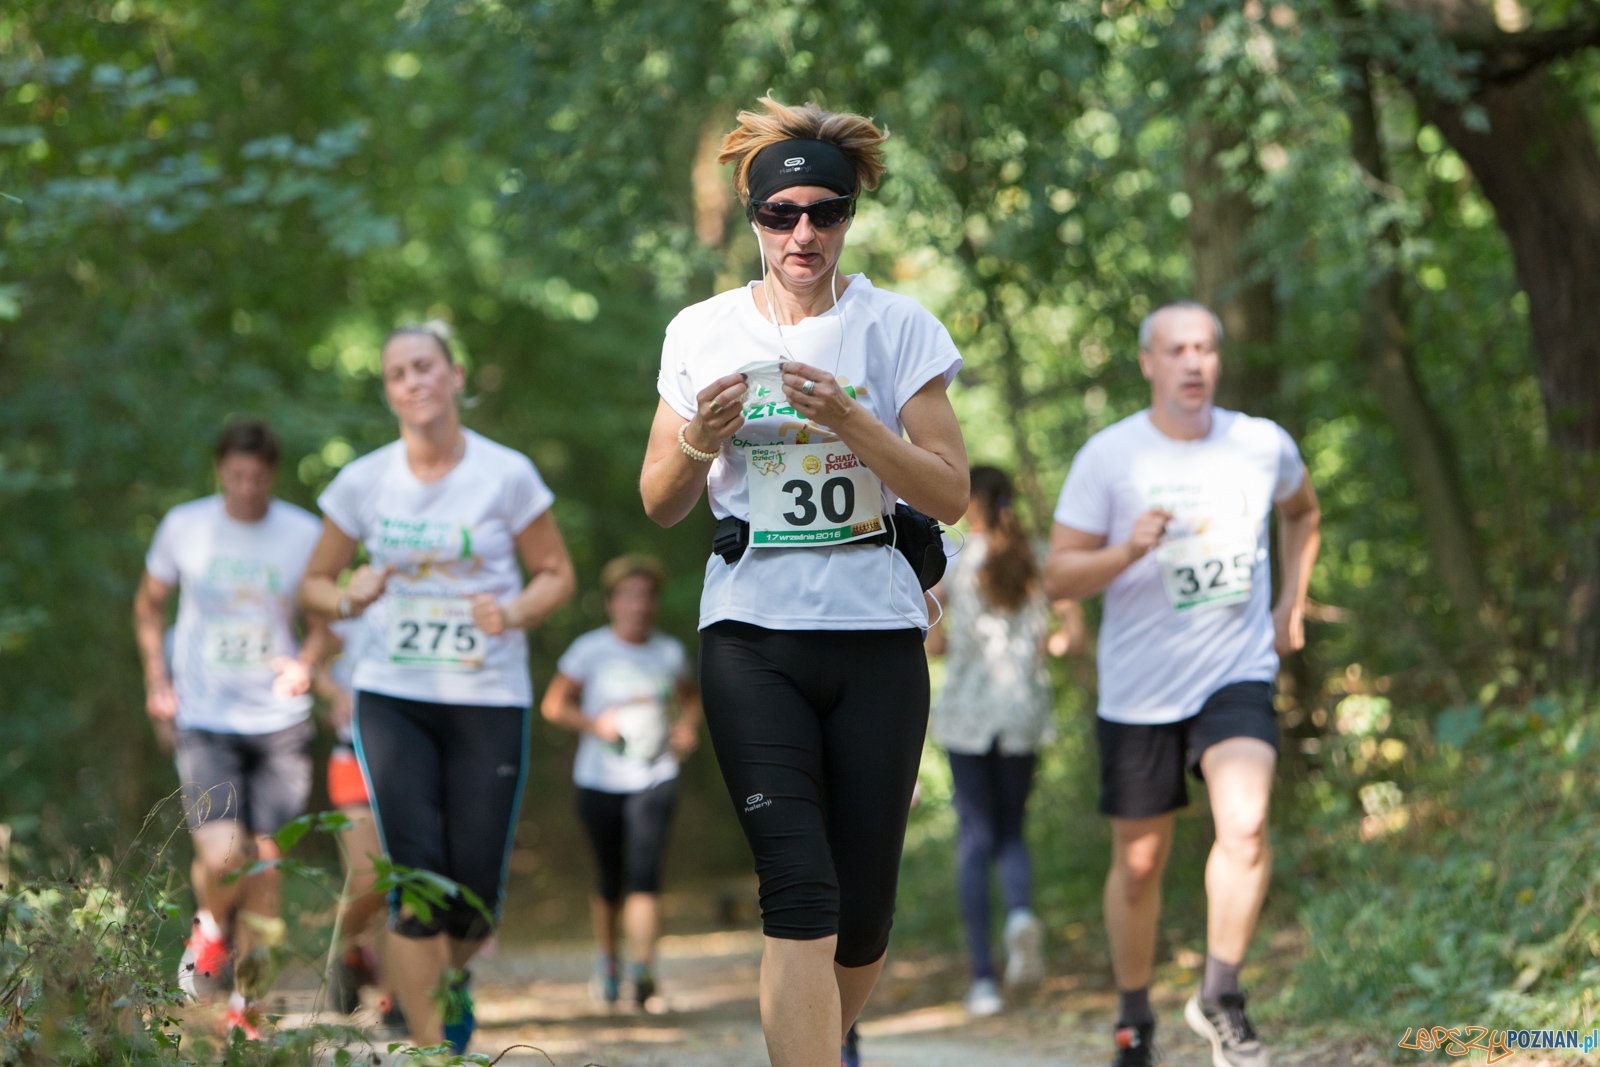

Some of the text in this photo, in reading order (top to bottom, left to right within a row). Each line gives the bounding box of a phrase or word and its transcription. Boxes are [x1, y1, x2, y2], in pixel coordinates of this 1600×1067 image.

[781, 476, 855, 526] 30
[815, 531, 841, 540] 2016
[1174, 553, 1253, 596] 325
[400, 621, 477, 651] 275
[744, 799, 772, 813] Kalenji
